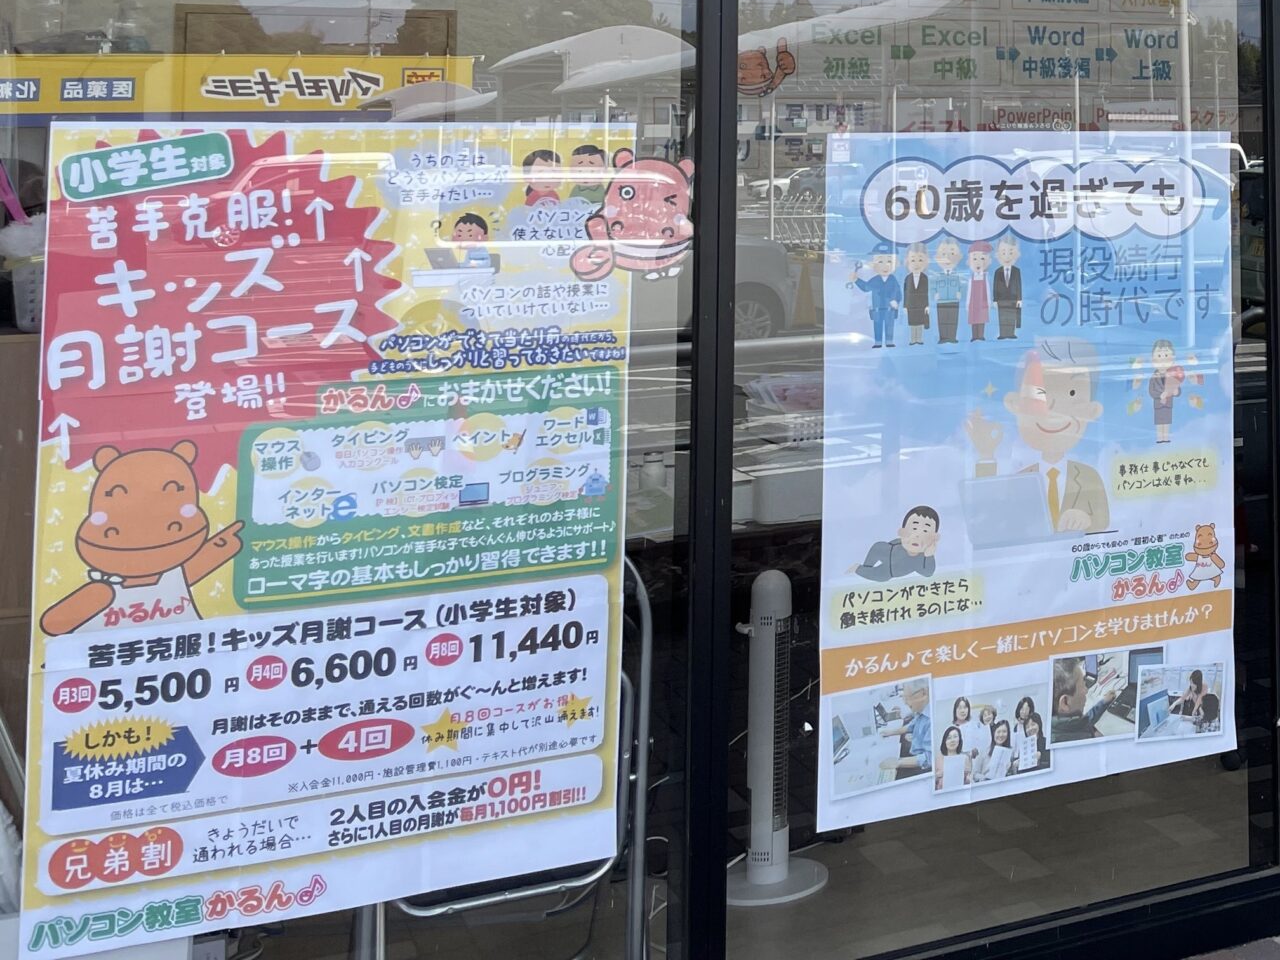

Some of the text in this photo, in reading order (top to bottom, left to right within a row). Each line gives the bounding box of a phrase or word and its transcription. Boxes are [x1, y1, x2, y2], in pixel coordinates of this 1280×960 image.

[811, 23, 882, 47] Excel
[921, 24, 988, 48] Excel
[1027, 25, 1085, 47] Word
[1123, 28, 1179, 50] Word
[823, 57, 871, 80] 初級
[933, 58, 978, 81] 中級
[1022, 57, 1091, 80] 中級後編
[1132, 58, 1172, 82] 上級
[69, 144, 227, 194] 小学生対象
[411, 153, 487, 167] うちの子は
[94, 232, 301, 318] キッズ
[1038, 243, 1184, 286] 現役続行
[462, 282, 608, 301] パソコンの話や授業に
[1039, 284, 1220, 328] の時代です
[46, 299, 369, 391] 月謝コース
[543, 416, 584, 431] ワード
[254, 439, 301, 455] マウス
[331, 427, 410, 447] タイピング
[454, 429, 511, 444] ペイント
[535, 431, 592, 447] エクセル
[260, 455, 294, 472] 操作
[500, 462, 591, 485] プログラミング
[278, 487, 342, 504] インター
[371, 474, 464, 495] パソコン検定
[285, 504, 332, 520] ネット
[1070, 542, 1186, 582] パソコン教室
[842, 577, 970, 609] パソコンができたら
[97, 668, 212, 713] 5,500
[290, 646, 397, 690] 6,600
[470, 620, 584, 663] 11,440
[222, 726, 393, 768] 月8回 4回
[62, 752, 188, 785] 夏休み期間の
[109, 794, 229, 822] 価格は全て税込価格で
[206, 815, 301, 843] きょうだいで
[64, 840, 172, 883] 兄弟割
